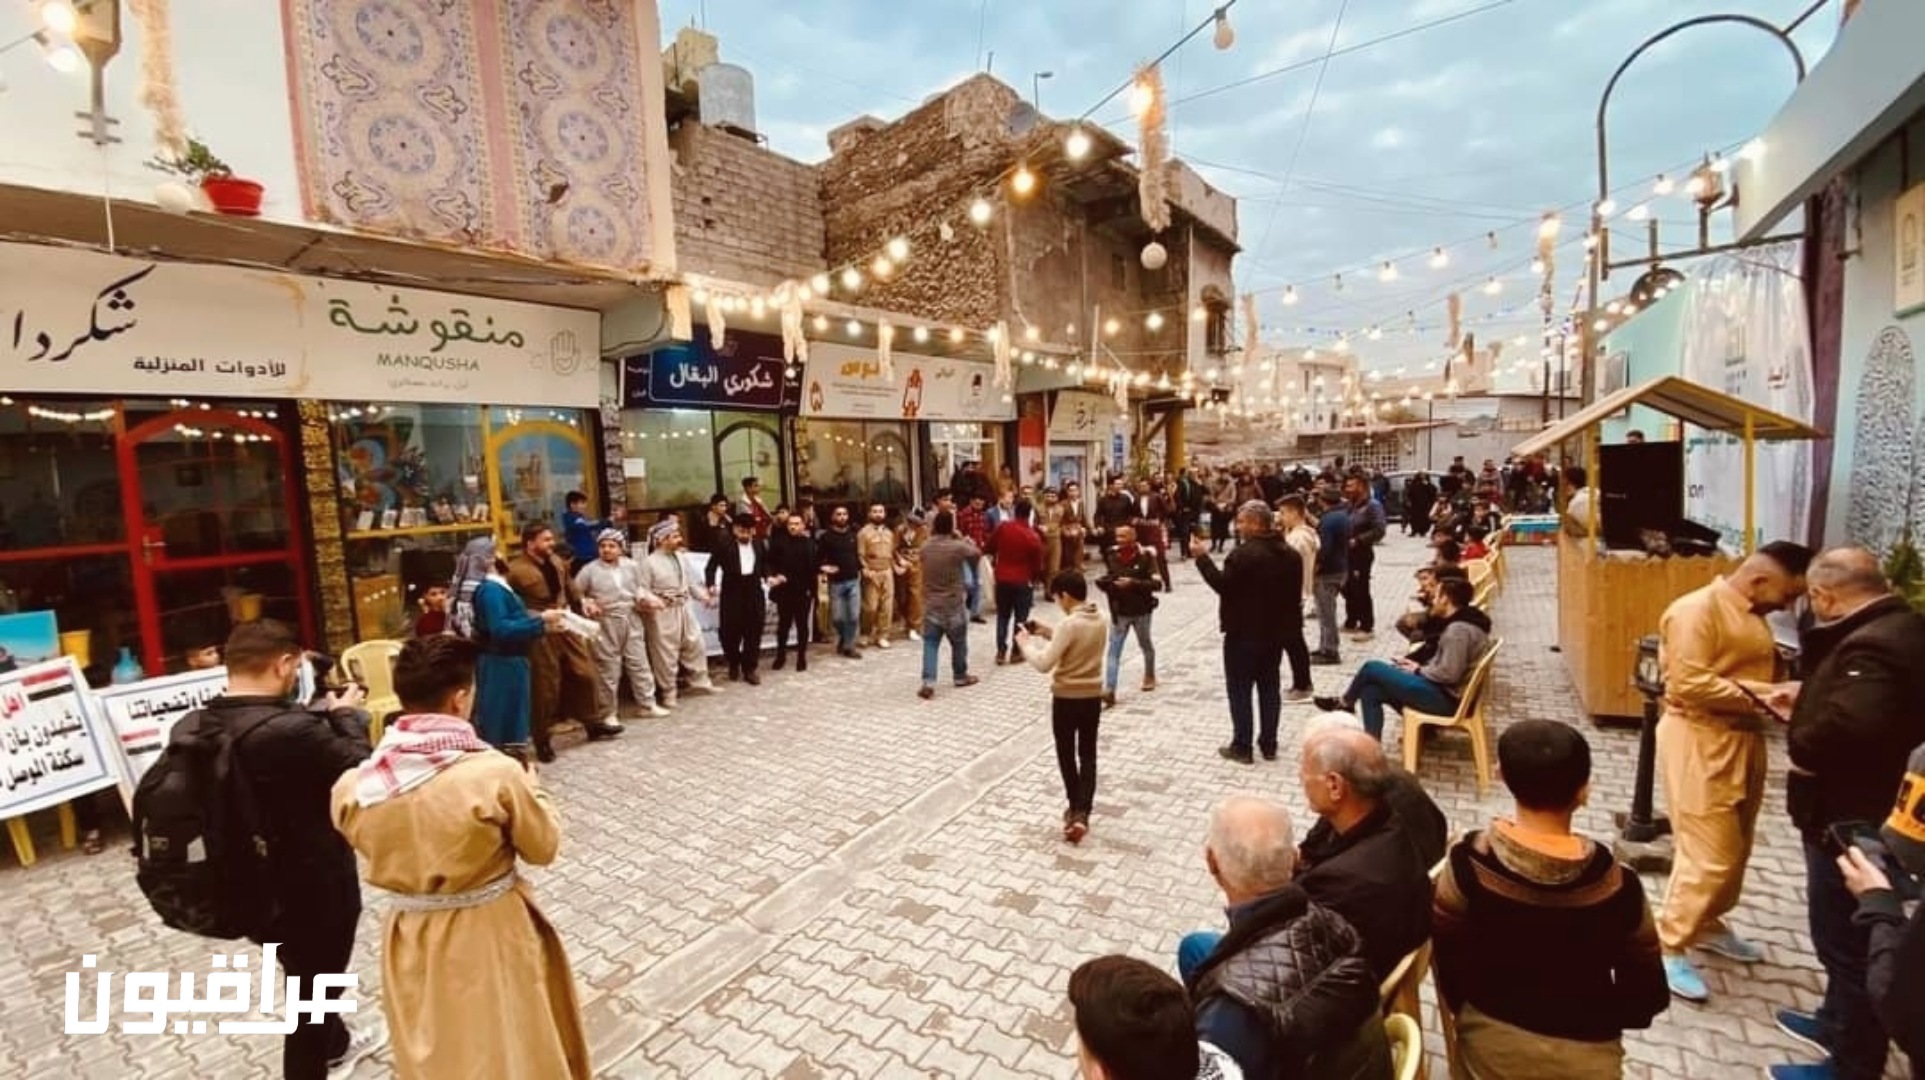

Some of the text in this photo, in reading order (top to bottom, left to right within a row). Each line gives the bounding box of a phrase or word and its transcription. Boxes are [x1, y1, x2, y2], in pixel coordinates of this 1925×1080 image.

[329, 294, 524, 352] منقوشة
[133, 356, 286, 377] للأدوات المنزلية
[377, 353, 480, 371] MANQUSHA
[669, 363, 774, 396] شكوري البقال
